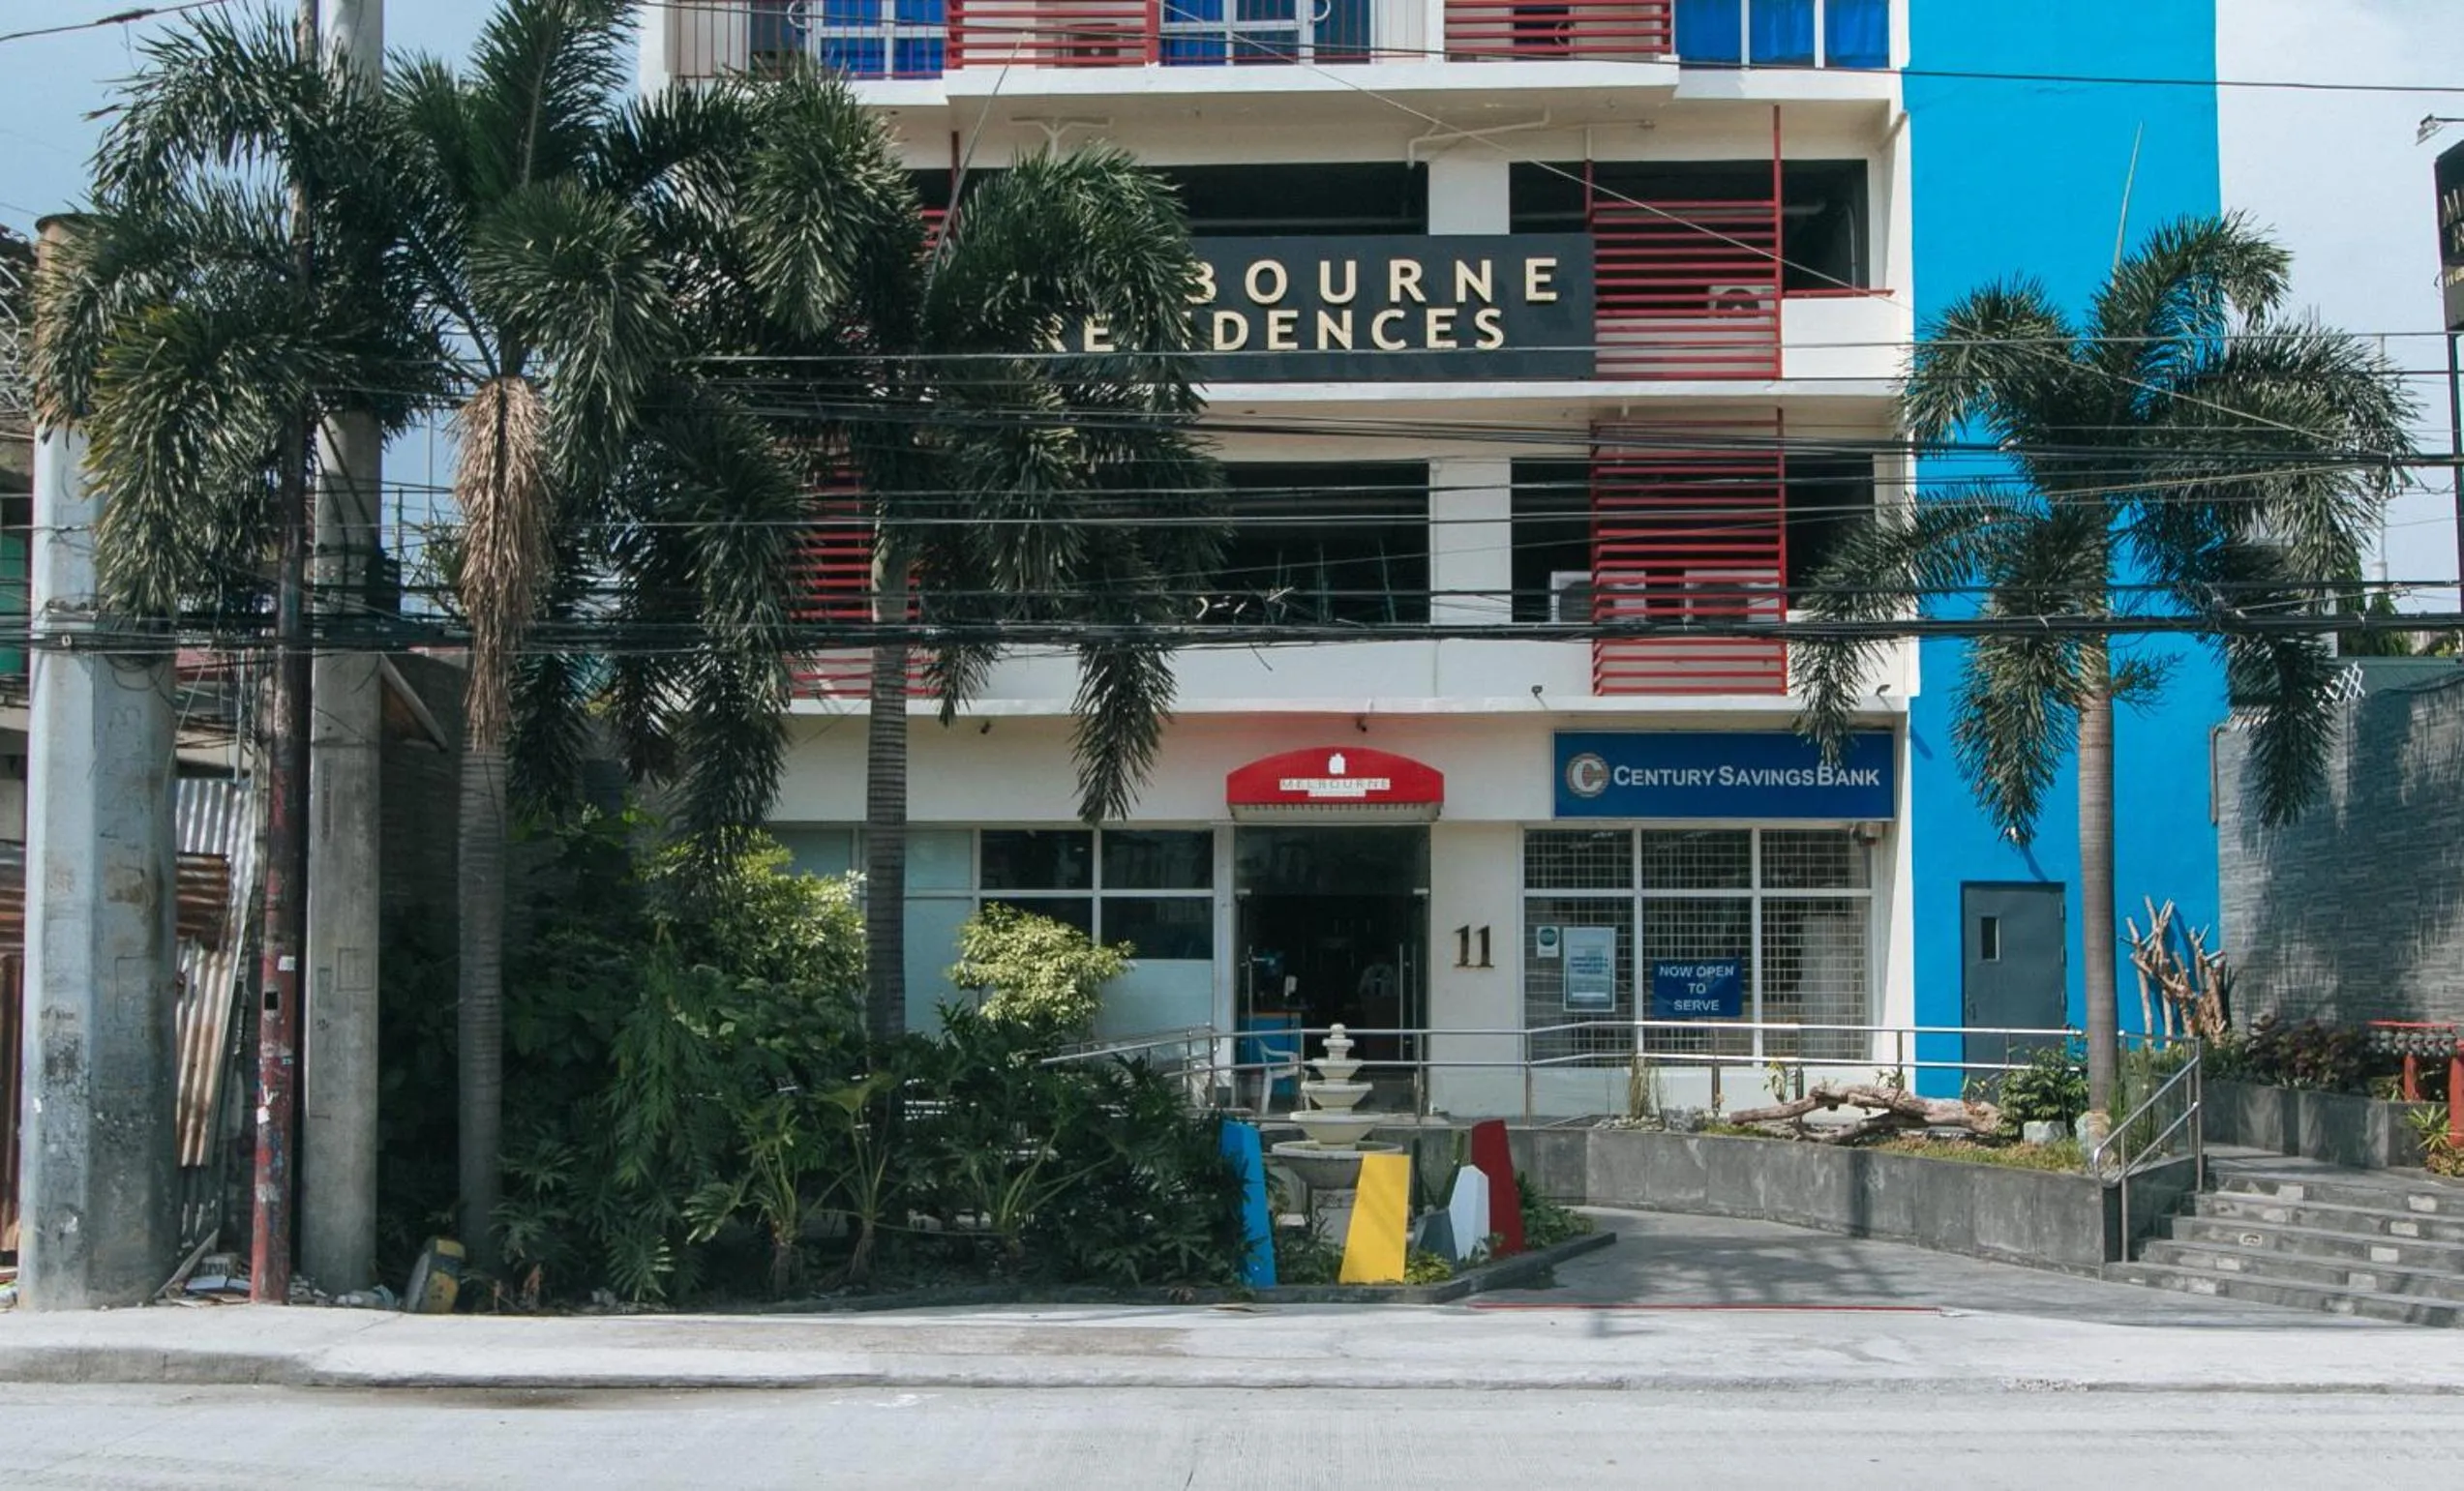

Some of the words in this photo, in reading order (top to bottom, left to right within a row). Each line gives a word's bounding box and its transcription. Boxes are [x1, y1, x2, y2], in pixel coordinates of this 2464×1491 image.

[1183, 257, 1558, 305] BOURNE
[1612, 765, 1714, 787] CENTURY
[1454, 924, 1495, 969] 11
[1659, 965, 1694, 978] NOW
[1696, 965, 1734, 978] OPEN
[1687, 982, 1706, 995] TO
[1673, 999, 1720, 1012] SERVE
